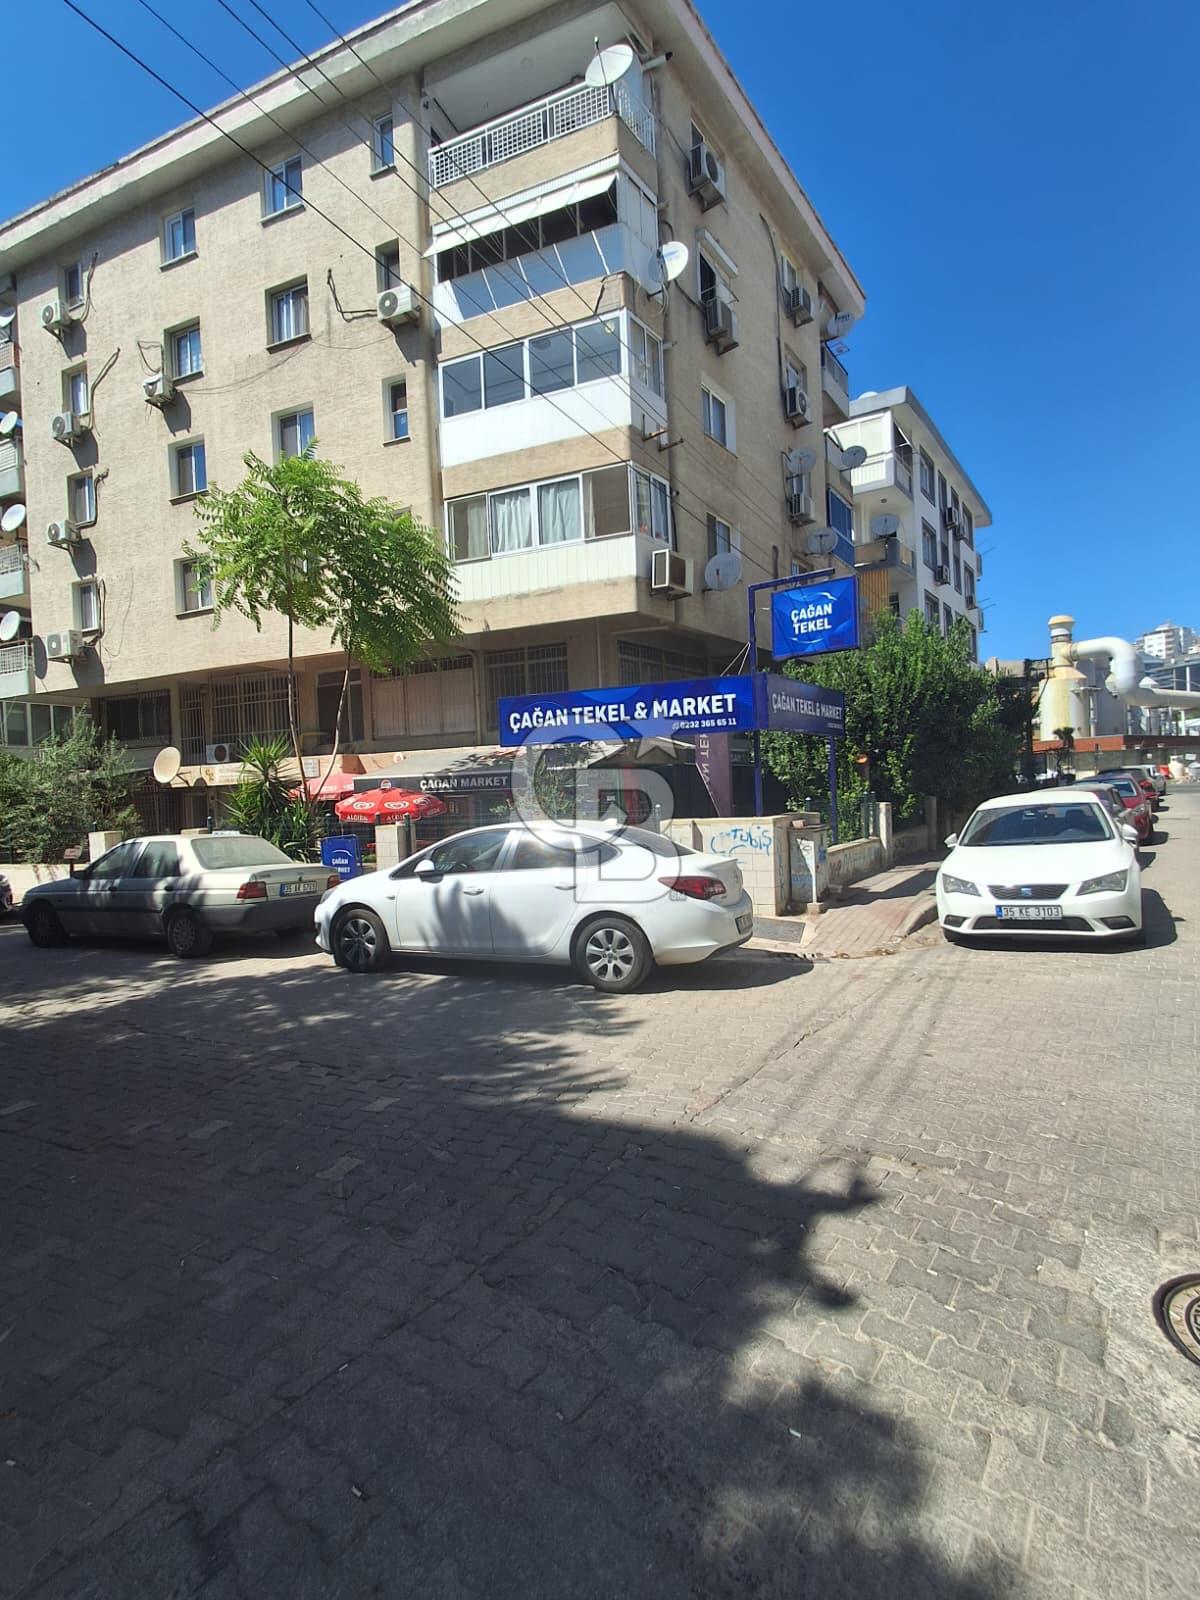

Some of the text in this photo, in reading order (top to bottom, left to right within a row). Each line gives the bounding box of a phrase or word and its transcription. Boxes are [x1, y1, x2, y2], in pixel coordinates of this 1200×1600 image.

[791, 603, 832, 624] ÇAĞAN
[792, 618, 832, 635] TEKEL
[509, 693, 737, 733] ÇAĞAN TEKEL & MARKET
[772, 692, 795, 714] ÇAĞAN
[796, 698, 815, 716] TEKEL
[821, 703, 842, 720] MARKET
[728, 717, 737, 726] 11
[461, 775, 507, 787] MARKET
[1003, 906, 1060, 917] 35 KE 3103
